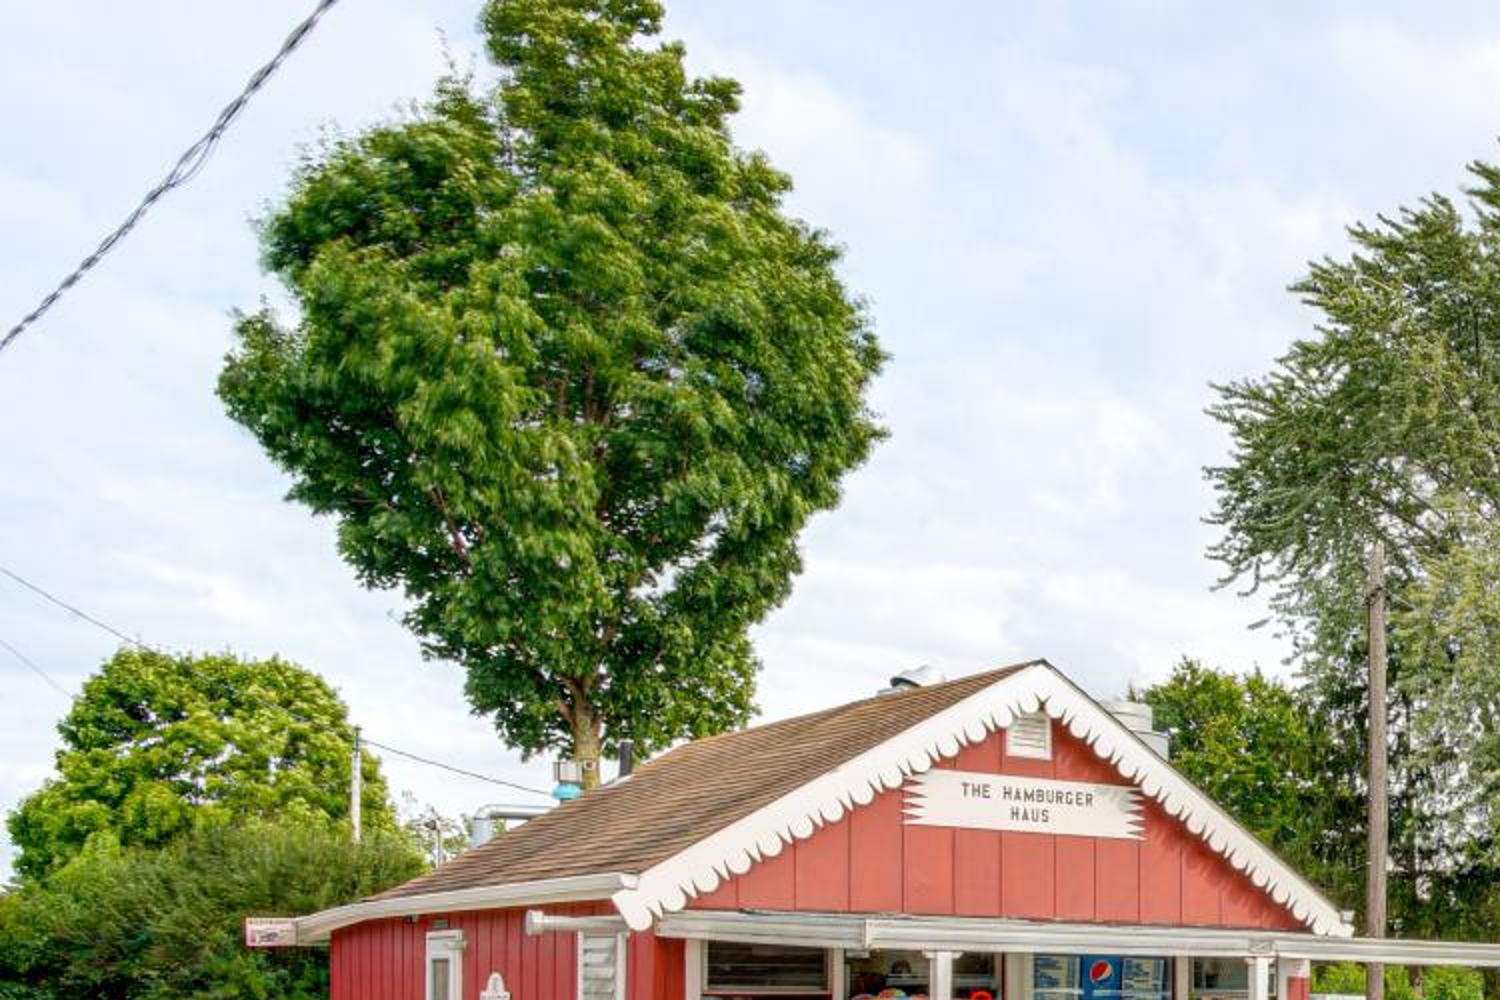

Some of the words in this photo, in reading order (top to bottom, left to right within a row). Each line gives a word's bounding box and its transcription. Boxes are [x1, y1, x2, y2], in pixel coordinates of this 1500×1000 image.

[960, 781, 992, 799] THE
[1002, 785, 1094, 807] HAMBURGER
[1010, 806, 1050, 823] HAUS
